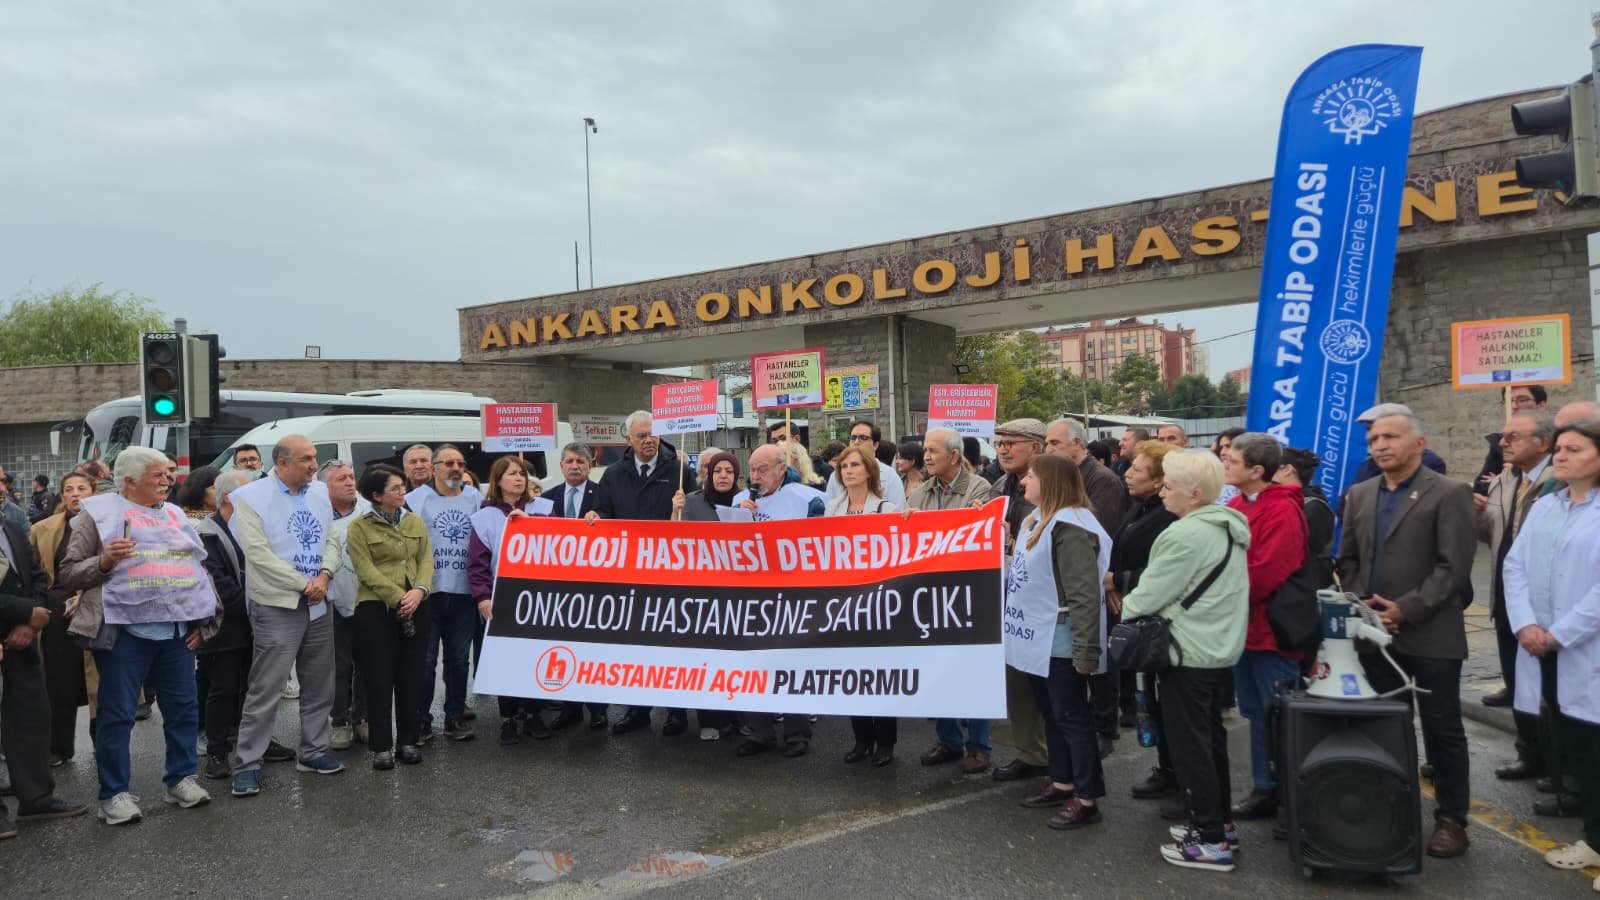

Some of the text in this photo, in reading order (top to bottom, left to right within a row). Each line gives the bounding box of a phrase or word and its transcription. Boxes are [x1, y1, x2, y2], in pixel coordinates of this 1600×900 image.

[1311, 77, 1402, 117] ANKARA TABİP ODASI
[1338, 165, 1378, 314] hekimlerle güçlü
[479, 299, 678, 349] ANKARA
[699, 238, 1030, 322] ONKOLOJİ
[1266, 162, 1329, 449] ARA TABİP ODASI
[1475, 327, 1544, 342] HASTANELER
[1480, 341, 1539, 354] HALKINDIR,
[766, 359, 809, 371] HASTANELER
[1477, 353, 1543, 366] SATILAMAZ!
[768, 380, 809, 392] SATILAMAZ!
[1327, 371, 1349, 422] gücü
[496, 406, 543, 415] HASTANELER
[506, 530, 628, 568] ONKOLOJİ
[635, 532, 769, 571] HASTANESİ
[776, 516, 996, 571] DEVREDİLEMEZ!
[515, 584, 974, 639] ONKOLOJİ HASTANESİNE SAHİP ÇIK!
[1005, 606, 1025, 622] ARA
[576, 661, 920, 700] HASTANEMİ AÇIN PLATFORMU
